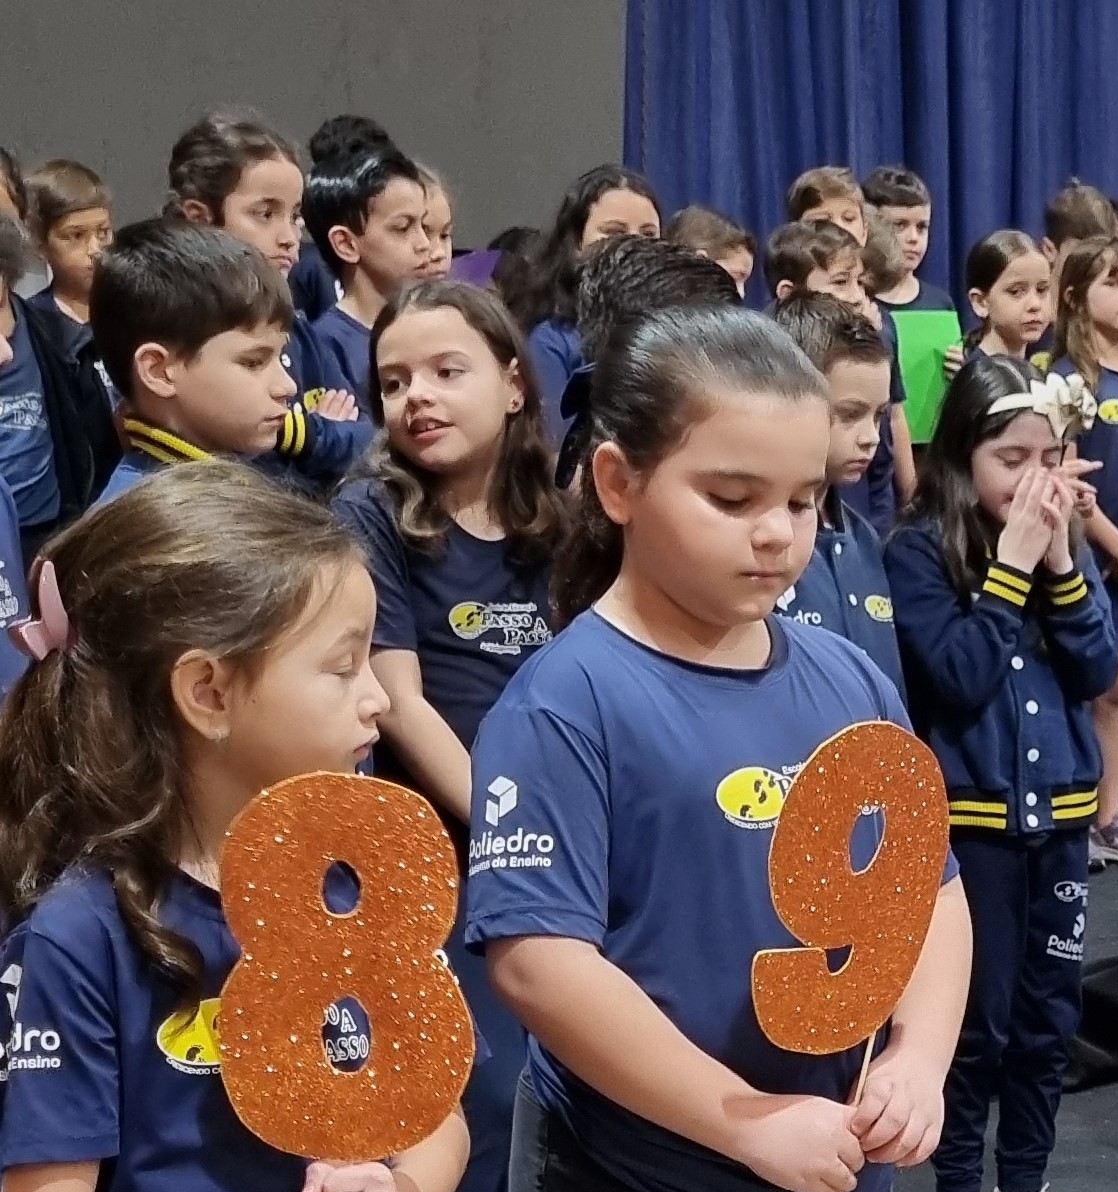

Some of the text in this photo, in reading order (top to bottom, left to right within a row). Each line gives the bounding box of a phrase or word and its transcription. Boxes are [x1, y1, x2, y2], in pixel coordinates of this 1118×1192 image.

[509, 853, 552, 868] Ensino
[752, 720, 950, 1056] 9
[1047, 934, 1084, 954] Polied
[220, 770, 476, 1161] 8
[325, 1034, 370, 1063] ASSO
